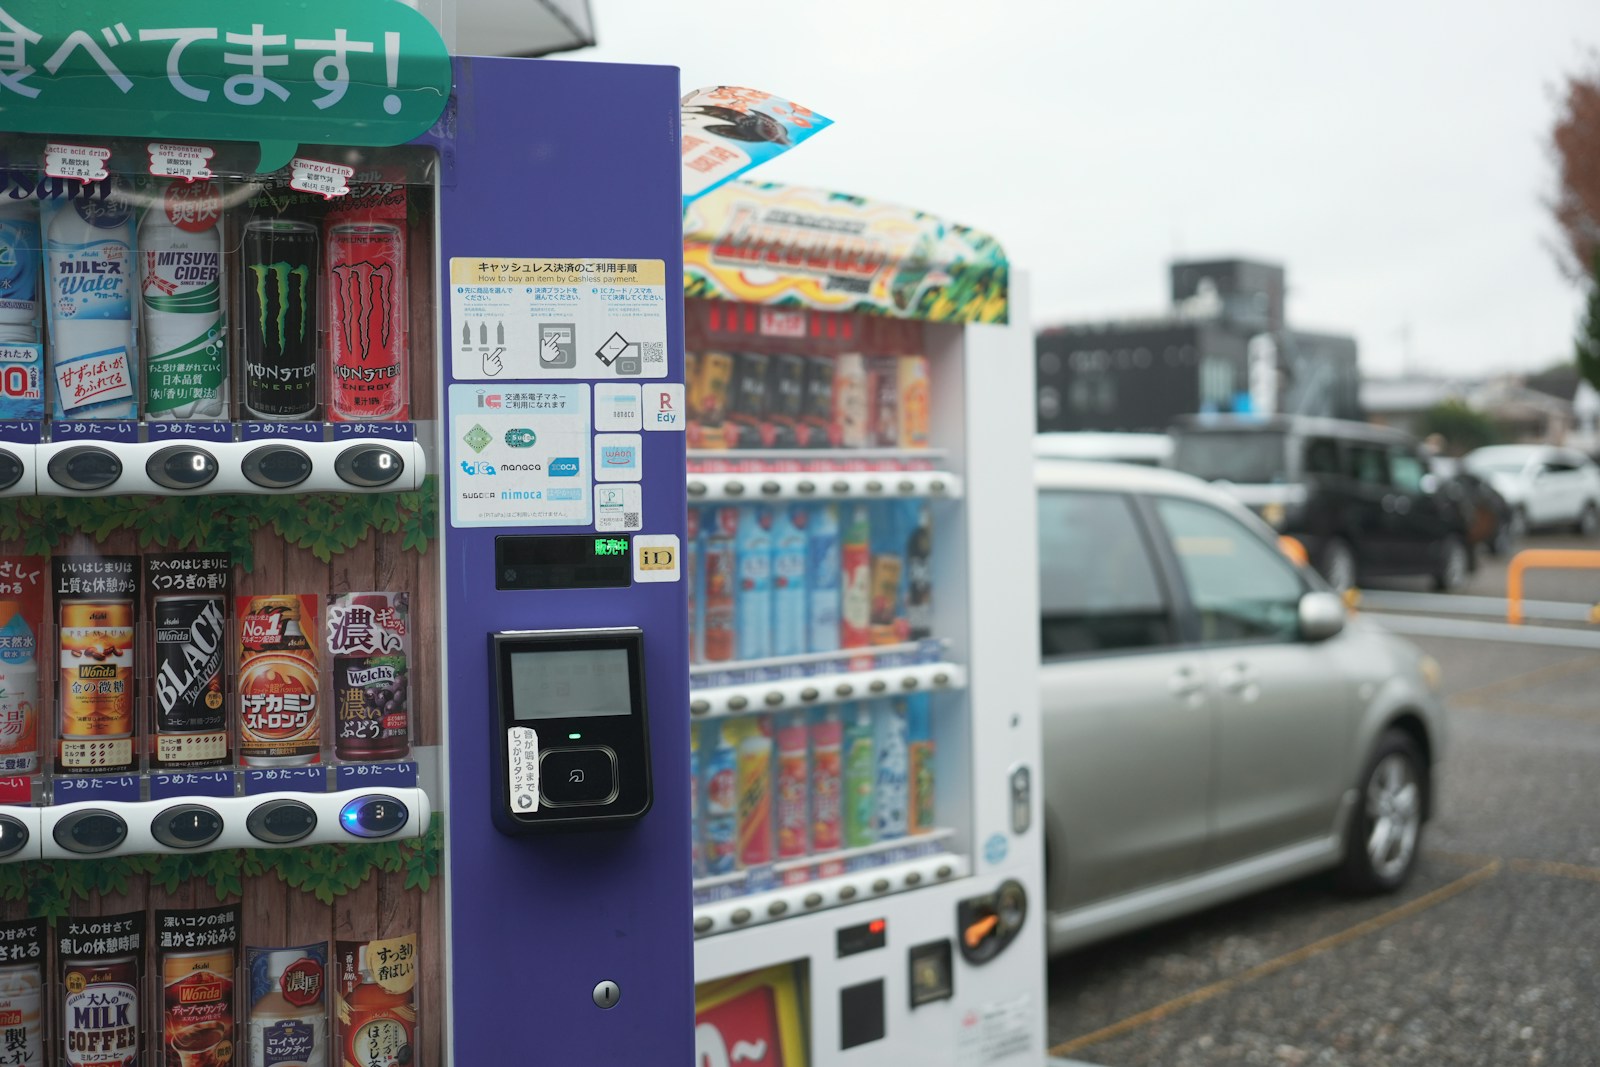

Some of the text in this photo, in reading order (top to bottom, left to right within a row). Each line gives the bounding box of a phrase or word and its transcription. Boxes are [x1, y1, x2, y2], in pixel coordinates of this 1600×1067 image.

[71, 148, 86, 156] acid
[89, 149, 109, 158] drink
[159, 145, 202, 153] Carbonated
[293, 160, 351, 176] Energy drink
[350, 183, 404, 200] モンスター
[171, 197, 218, 225] 爽快
[157, 251, 218, 266] MITSUYA
[60, 260, 120, 274] カルピス
[174, 266, 218, 280] CIDER
[478, 262, 638, 273] キャッシュレス決済のご利用手順
[59, 275, 123, 295] Water
[508, 275, 523, 284] buy
[557, 275, 565, 284] by
[568, 275, 600, 283] Cashless
[603, 276, 639, 284] payment.
[149, 363, 221, 373] ずっと受け継がれていく
[74, 372, 123, 397] あふれてる
[163, 374, 202, 386] 日本品質
[252, 380, 311, 391] ENERGY
[342, 383, 391, 391] ENERGY
[353, 397, 368, 406] 果汁
[505, 401, 566, 409] ご利用になれます
[660, 392, 673, 409] R
[657, 413, 676, 423] Edy
[59, 423, 131, 433] つめた〜い
[155, 423, 226, 433] つめた〜い
[248, 423, 318, 433] つめた〜い
[340, 423, 408, 433] つめた〜い
[551, 463, 577, 471] ICOCA
[501, 489, 542, 500] nimoca
[594, 538, 629, 555] 販売中
[150, 558, 228, 570] 次へのはじまりに
[643, 551, 672, 566] iD
[61, 562, 133, 573] いいはじまりは
[58, 577, 136, 593] 上質な休憩から
[151, 573, 227, 590] くつろぎの香り
[89, 612, 107, 620] Asahi
[158, 630, 189, 640] Wonda
[331, 608, 401, 651] 濃い
[156, 599, 225, 716] BLACK
[80, 665, 115, 677] Wonda
[348, 666, 392, 685] Welch's
[72, 681, 124, 694] 金の微糖
[182, 685, 198, 705] The
[241, 694, 316, 713] ドデカミン
[340, 688, 382, 720] 濃い
[247, 712, 308, 729] ストロング
[340, 720, 380, 739] ぶどう
[513, 730, 523, 793] しっかりタッチ
[523, 729, 535, 792] 音が鳴るまで
[251, 768, 321, 780] つめた〜い
[343, 764, 411, 776] つめた〜い
[61, 777, 133, 789] つめた〜い
[157, 772, 227, 785] つめた〜い
[163, 911, 234, 928] 深いコクの余韻
[69, 920, 133, 934] 大人の甘さで
[160, 926, 236, 948] 温かさが沁みる
[60, 934, 140, 955] 癒しの休憩時間
[376, 943, 414, 964] すっきり
[377, 963, 414, 981] 香ばしい
[286, 970, 320, 995] 濃厚
[87, 993, 119, 1006] 大人の
[182, 987, 220, 1001] Wonda
[171, 1002, 228, 1016] ディープマウンテン
[74, 1003, 131, 1030] MILK
[68, 1026, 136, 1052] COFFEE
[268, 1035, 309, 1047] ロイヤル
[80, 1052, 124, 1062] ミルクコーヒー
[265, 1045, 312, 1056] ミルクティー
